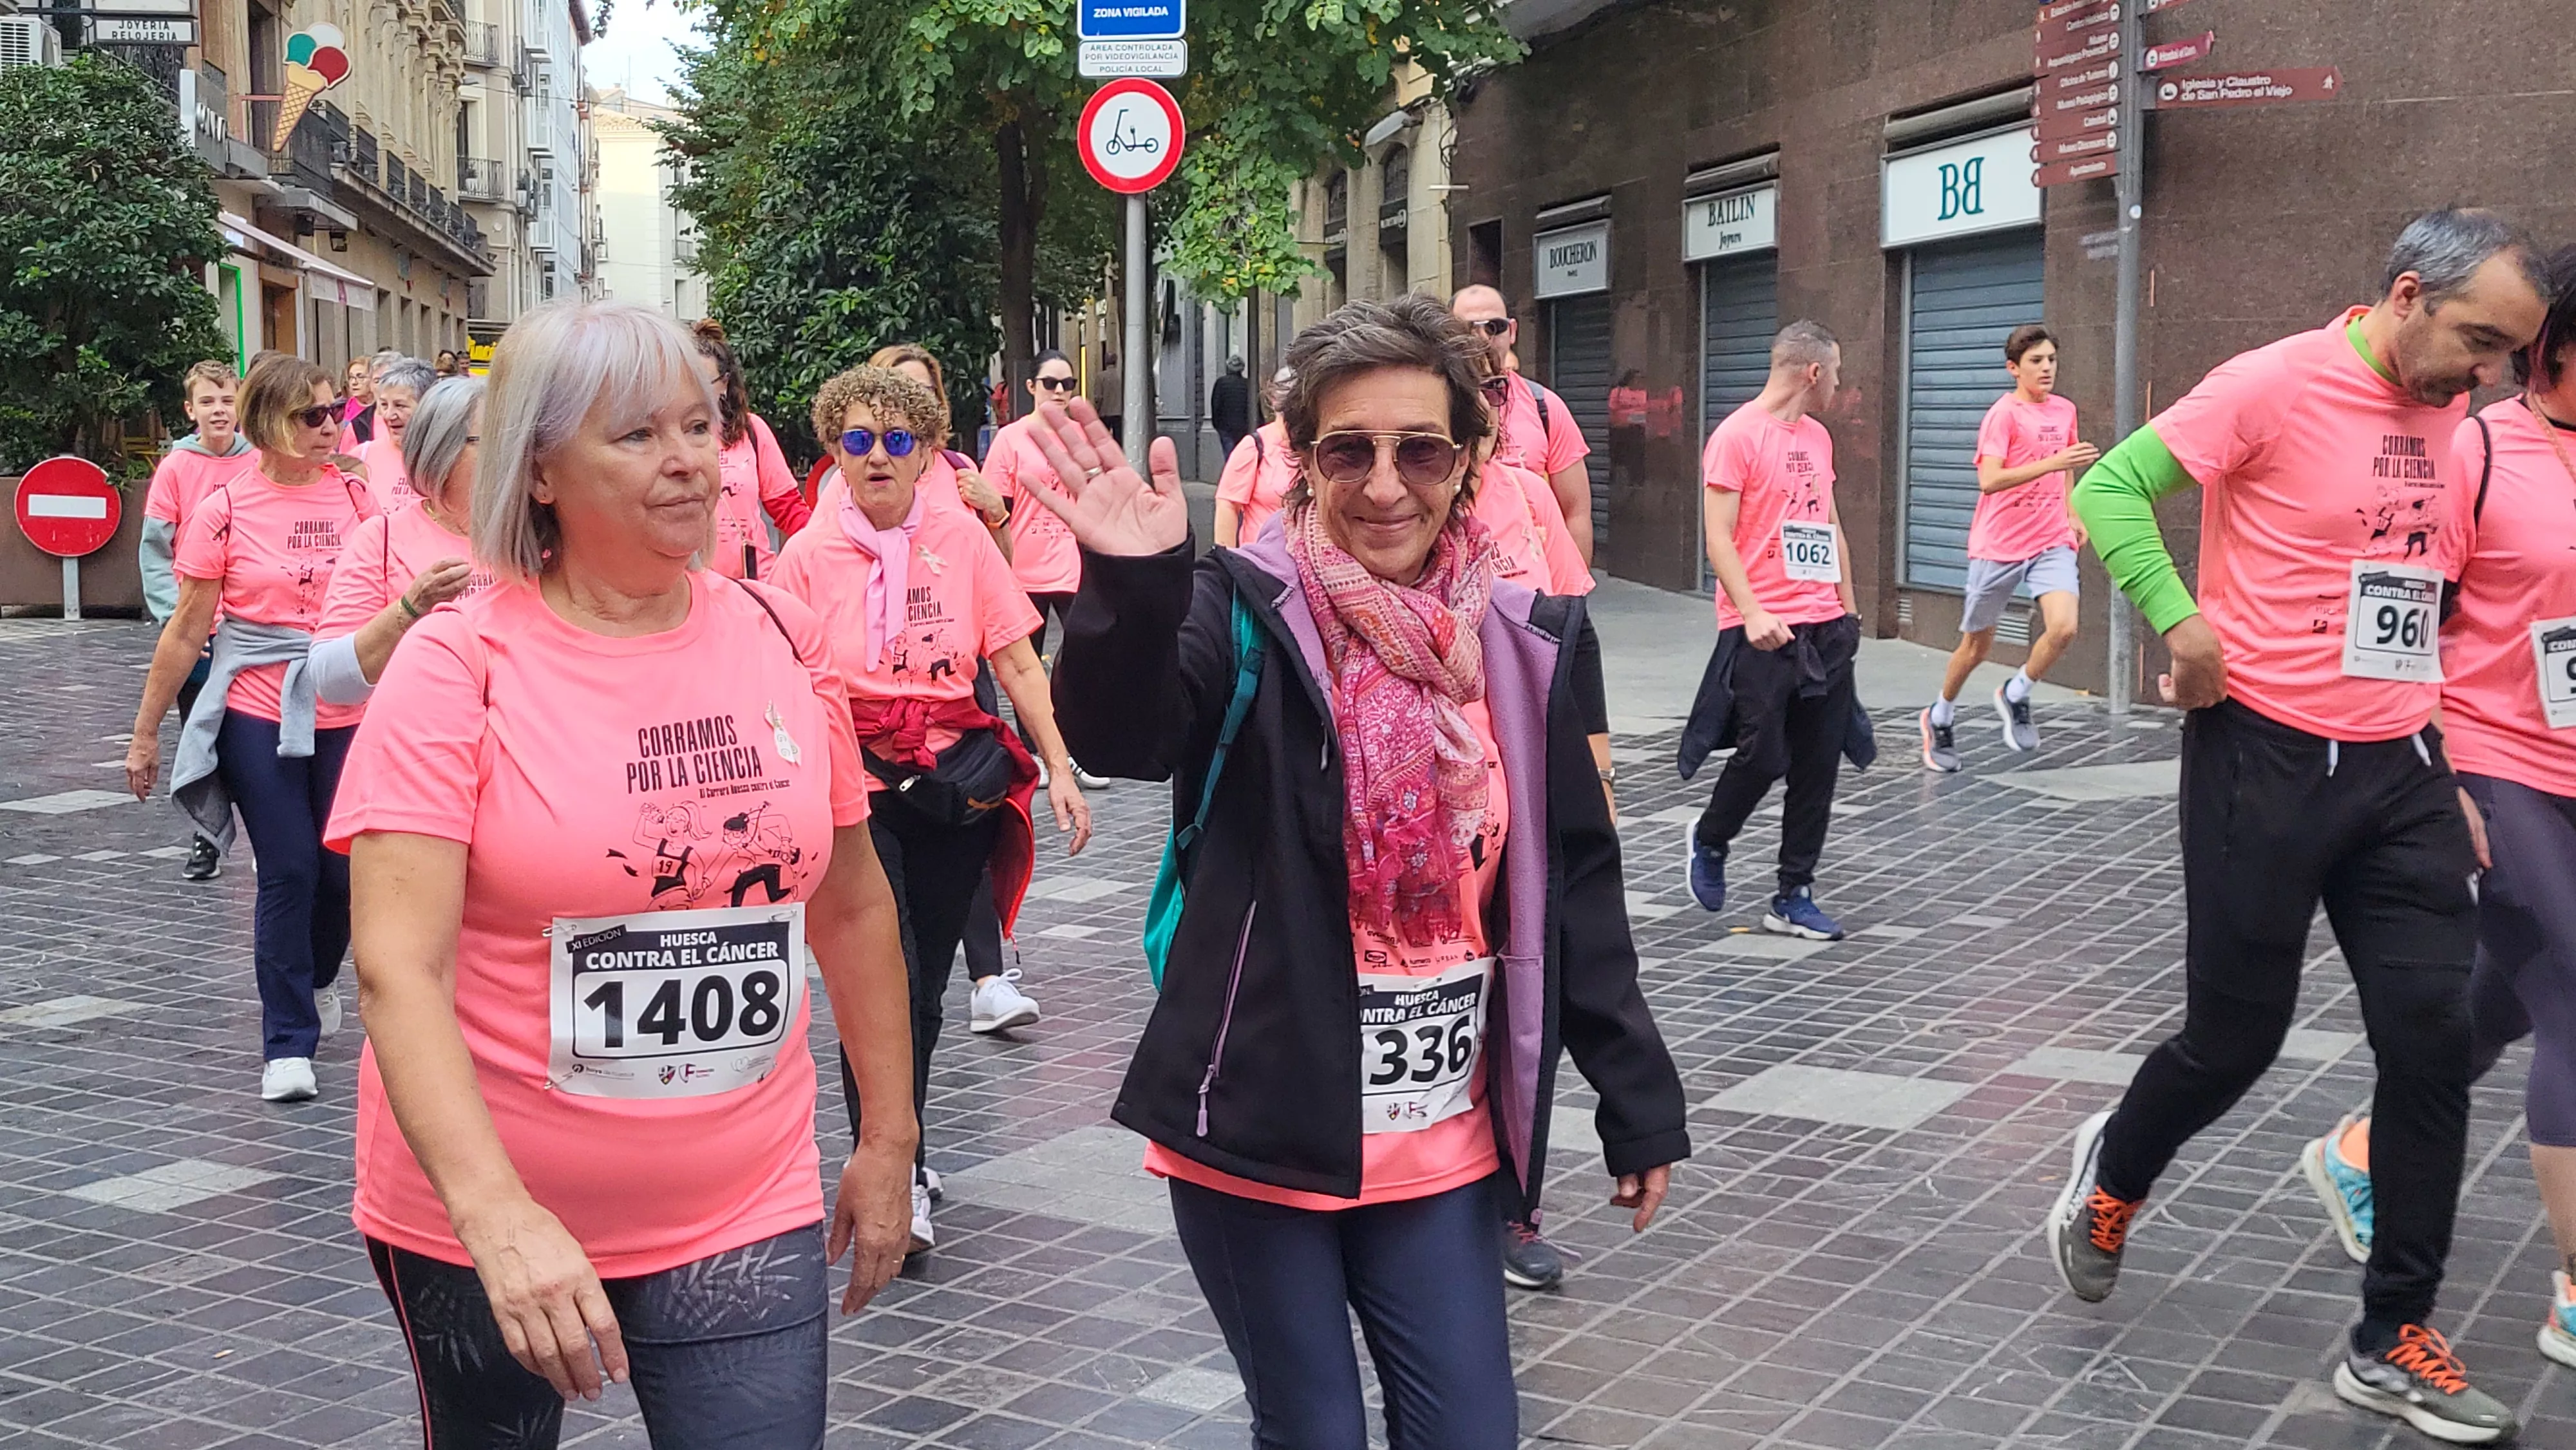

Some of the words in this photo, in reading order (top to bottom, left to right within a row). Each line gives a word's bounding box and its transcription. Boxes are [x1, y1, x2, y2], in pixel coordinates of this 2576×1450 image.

[1094, 8, 1122, 18] ZONA
[1123, 6, 1169, 17] VIGILADA
[118, 21, 170, 30] JOYERIA
[111, 31, 177, 41] RELOJERIA
[1105, 52, 1179, 61] VIDEOVIGILANCIA
[2182, 78, 2216, 91] Iglesia
[2217, 79, 2225, 89] y
[2226, 75, 2272, 88] Claustro
[2182, 91, 2196, 101] de
[2197, 89, 2219, 100] San
[2221, 88, 2253, 99] Pedro
[2253, 86, 2264, 97] el
[2266, 84, 2293, 98] Viejo
[1549, 240, 1598, 268] BOUCHERON
[2382, 435, 2426, 457] CORRAMOS
[2372, 457, 2389, 477] POR
[2392, 458, 2401, 478] LA
[2404, 458, 2436, 480] CIENCIA
[294, 520, 334, 534] CORRAMOS
[287, 535, 301, 550] POR
[304, 534, 312, 548] LA
[314, 534, 342, 547] CIENCIA
[1786, 541, 1831, 565] 1062
[906, 586, 931, 605] AMOS
[2366, 585, 2411, 600] CONTRA
[908, 601, 942, 622] CIENCIA
[2376, 605, 2430, 649] 960
[638, 715, 737, 758] CORRAMOS
[626, 759, 663, 795] POR
[667, 756, 689, 789] LA
[693, 745, 763, 785] CIENCIA
[572, 940, 583, 952] XI
[660, 931, 718, 948] HUESCA
[586, 950, 676, 970] CONTRA
[681, 948, 702, 966] EL
[706, 941, 779, 964] CÁNCER
[1394, 990, 1439, 1007] HUESCA
[583, 970, 781, 1050] 1408
[1361, 1007, 1406, 1024] NTRA
[1408, 1005, 1424, 1019] EL
[1426, 992, 1477, 1015] CÁNCER
